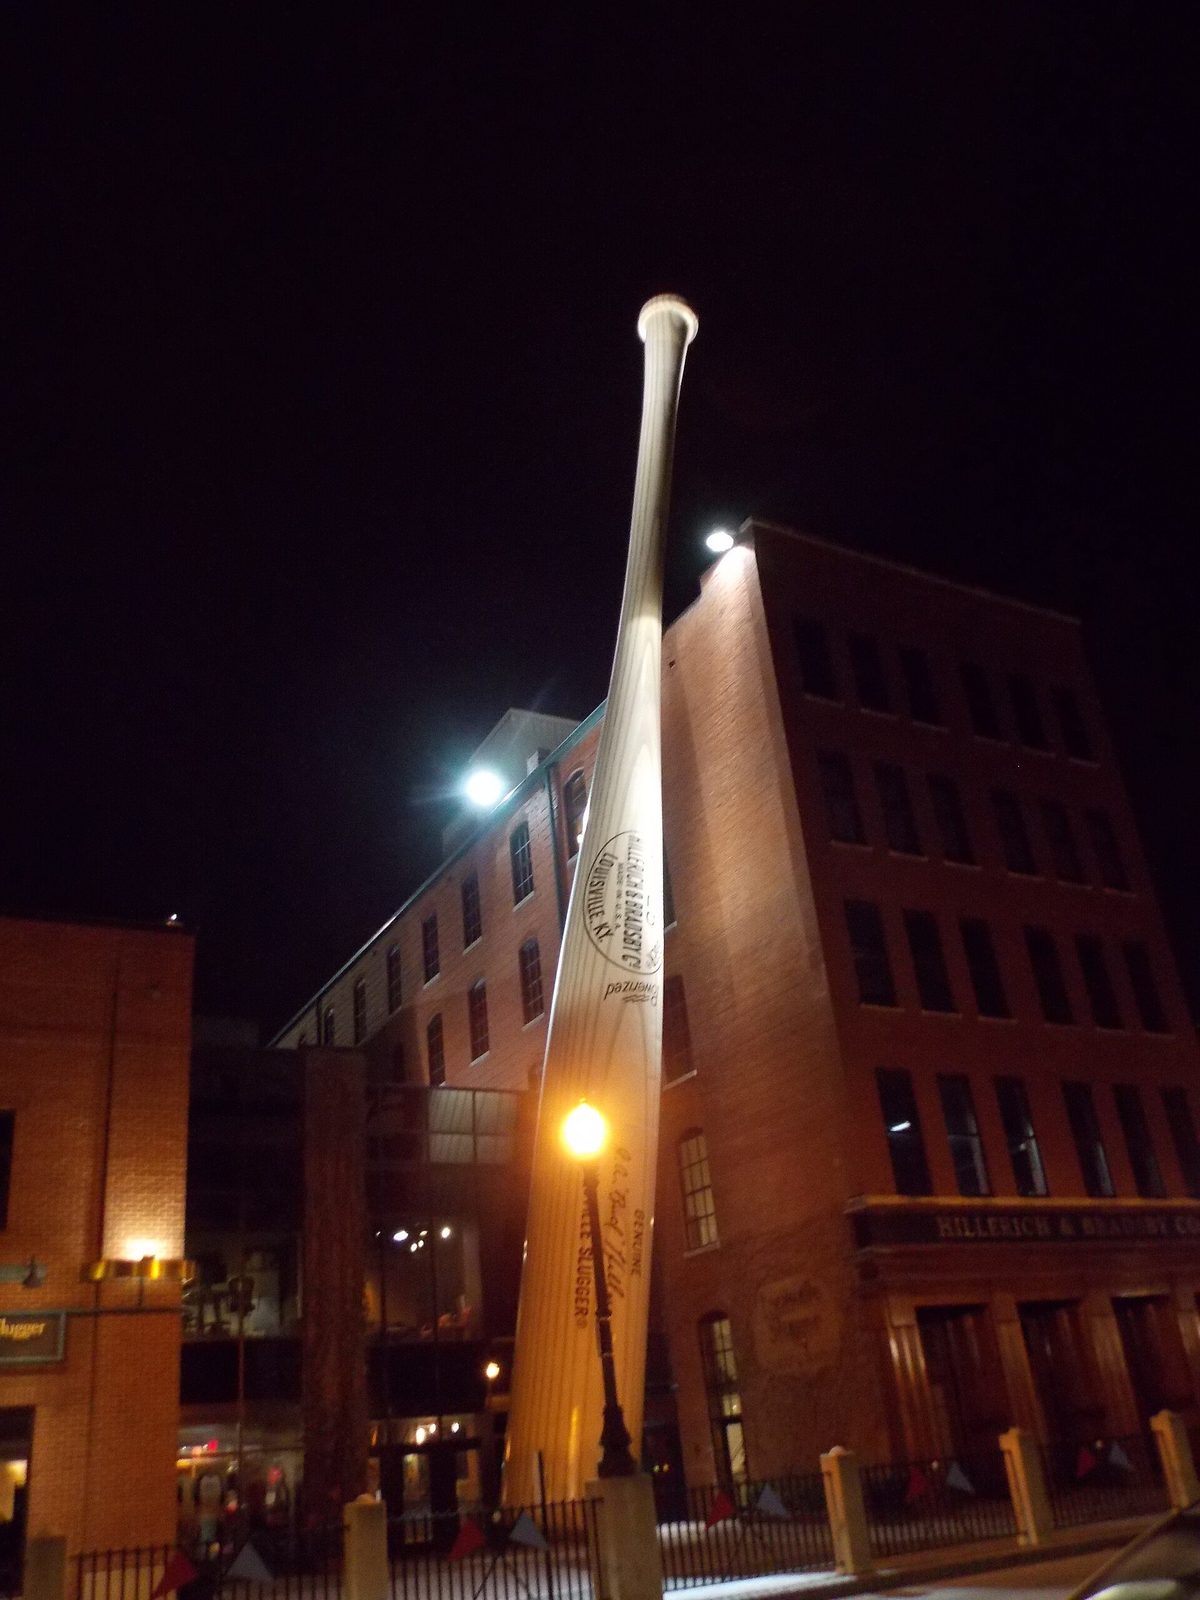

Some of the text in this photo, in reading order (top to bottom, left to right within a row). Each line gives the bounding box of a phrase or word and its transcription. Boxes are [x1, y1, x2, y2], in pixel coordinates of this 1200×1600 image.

[623, 900, 643, 952] BRADSBY
[631, 1209, 646, 1277] GENUINE
[936, 1215, 1051, 1238] HILLERICH
[1082, 1215, 1169, 1236] BRADBY
[0, 1317, 46, 1340] lugger
